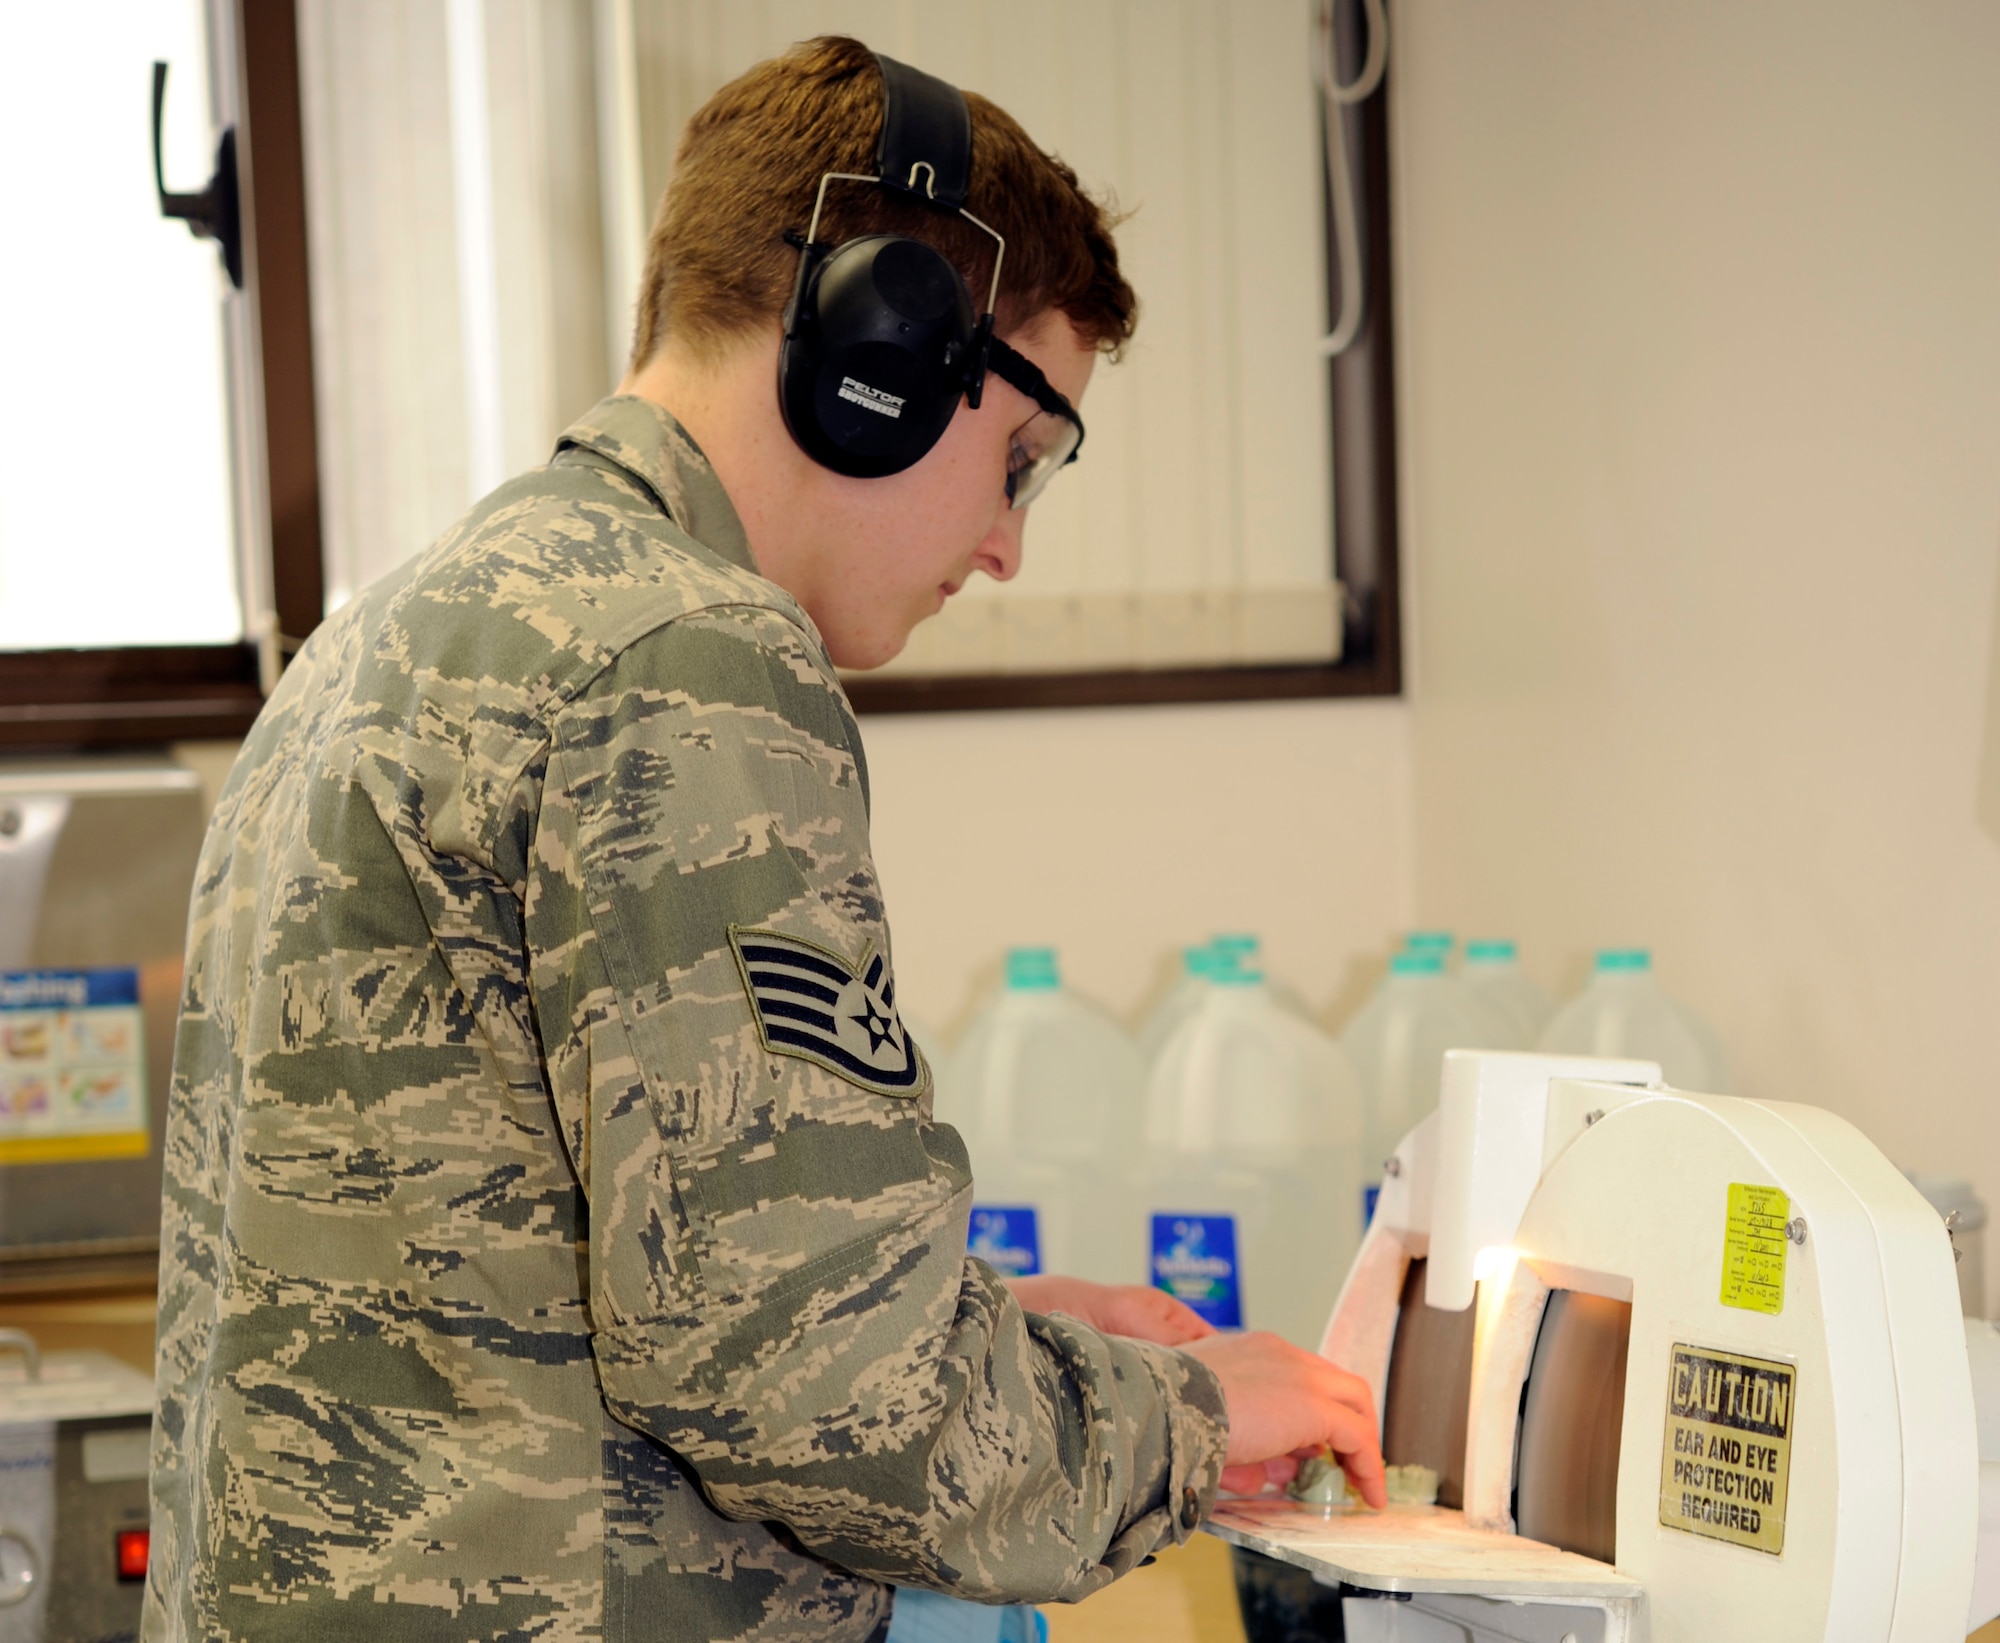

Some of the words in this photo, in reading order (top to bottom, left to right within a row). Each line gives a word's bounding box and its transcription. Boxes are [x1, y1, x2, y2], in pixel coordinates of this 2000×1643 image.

[842, 376, 907, 406] PELTOR
[1673, 1363, 1788, 1429] CAUTION
[1674, 1427, 1705, 1457] EAR
[1708, 1436, 1741, 1465] AND
[1746, 1445, 1778, 1473] EYE
[1674, 1461, 1774, 1506] PROTECTION
[1681, 1493, 1761, 1534] REQUIRED
